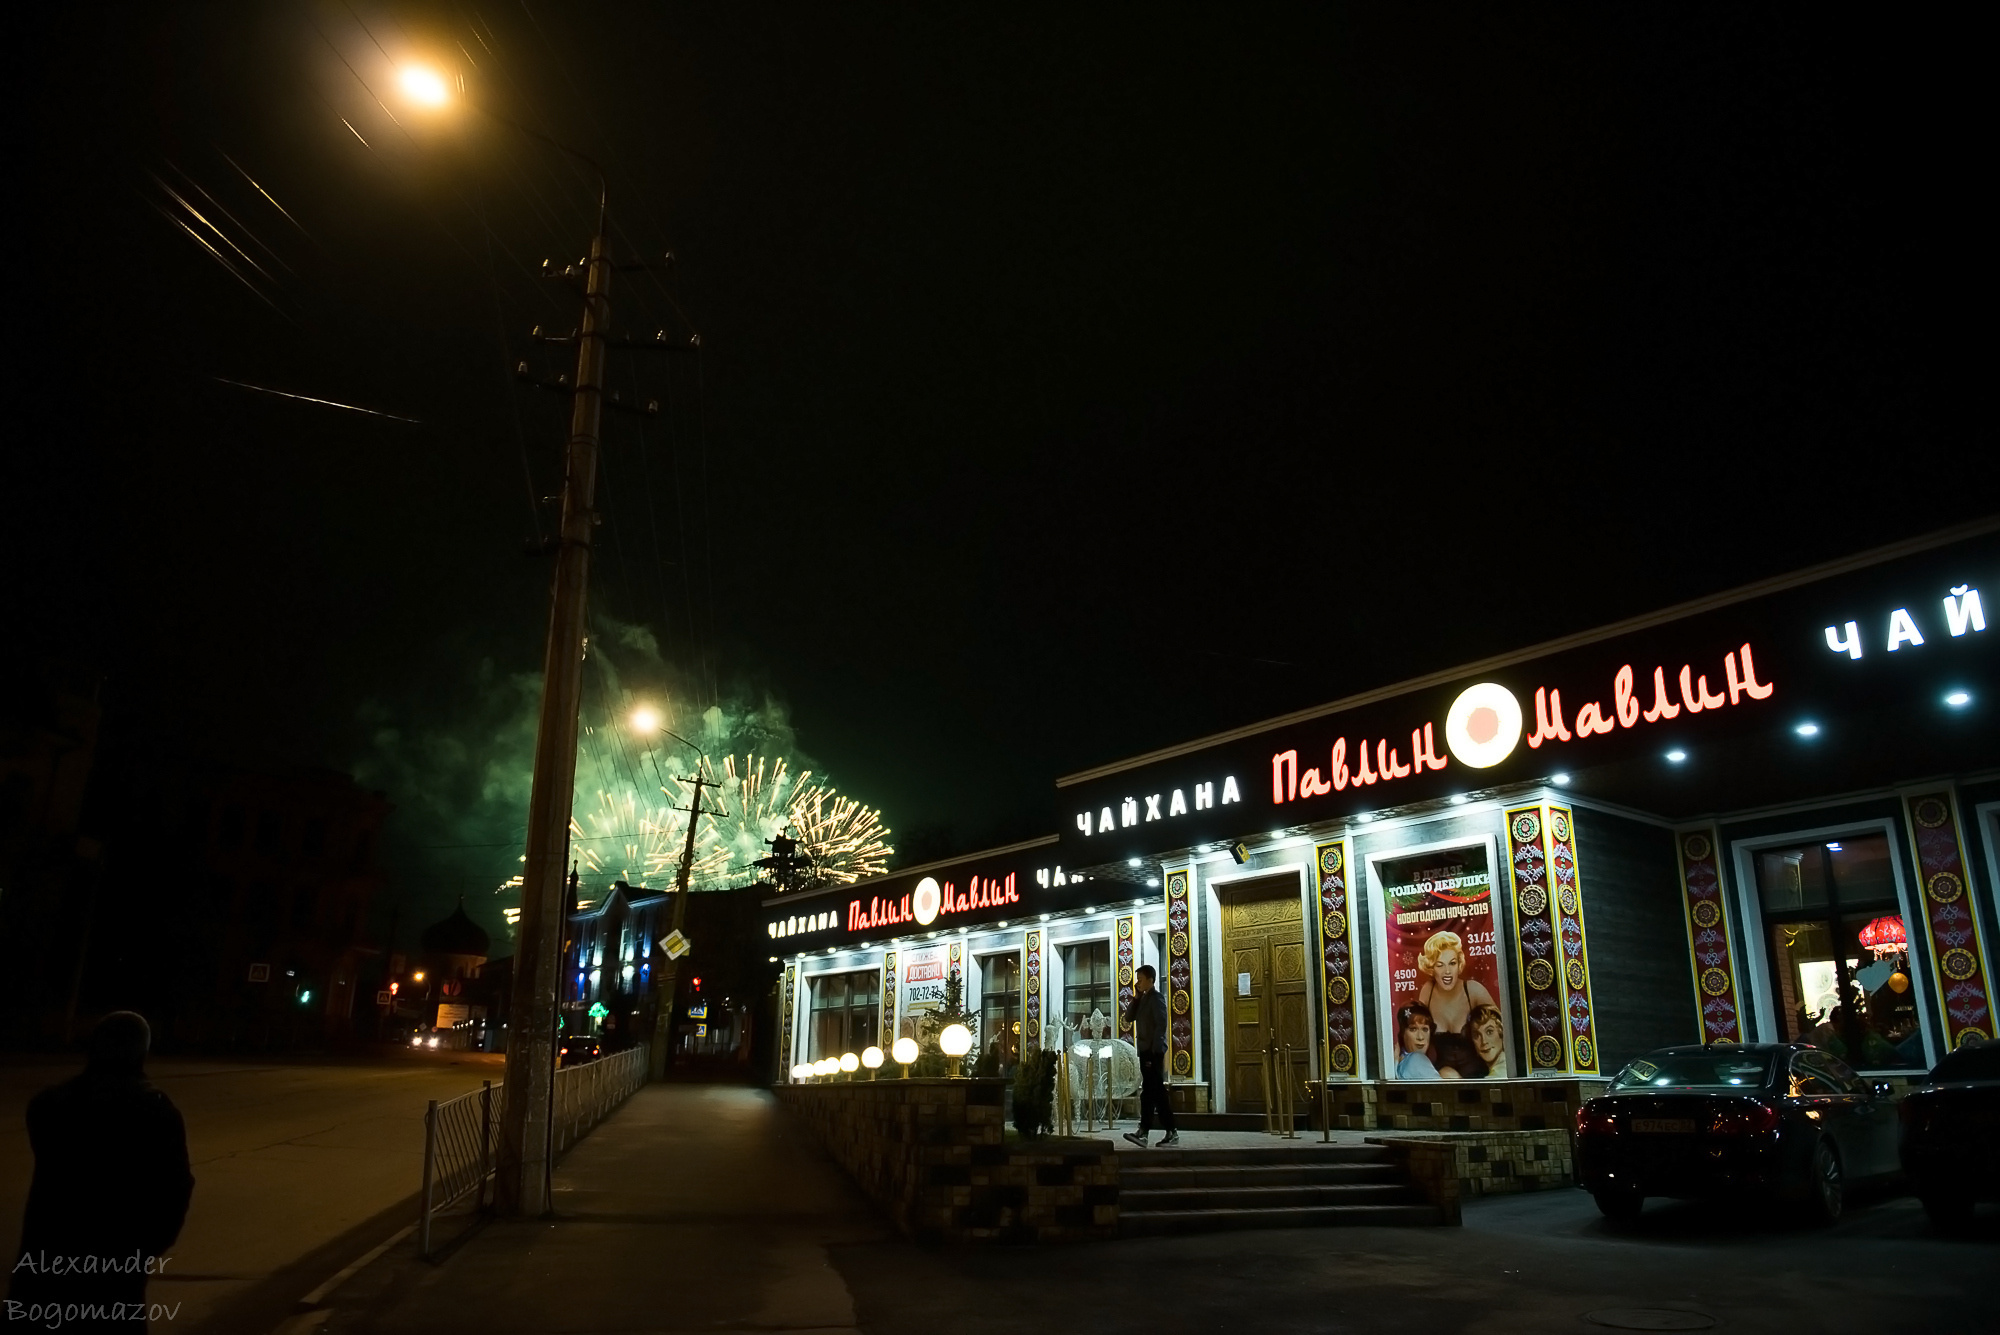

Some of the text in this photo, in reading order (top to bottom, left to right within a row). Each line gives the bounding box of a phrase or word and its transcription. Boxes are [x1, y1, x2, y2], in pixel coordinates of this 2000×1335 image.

[1824, 583, 1986, 660] ЧАЙ
[1272, 642, 1774, 804] Павлин Мавлин
[1076, 775, 1241, 836] ЧАЙХАНА
[1389, 882, 1433, 898] ТОЛЬКО
[847, 871, 1020, 932] Павлин Мавлин
[768, 910, 839, 939] ЧАЙХАНА
[1396, 908, 1446, 925] НОВОГОДНЯЯ
[1467, 932, 1495, 944] 31/12
[1469, 945, 1497, 957] 22:00
[909, 963, 941, 981] ДОСТАВКИ
[1394, 968, 1417, 980] 4500
[1395, 980, 1418, 992] РУБ.
